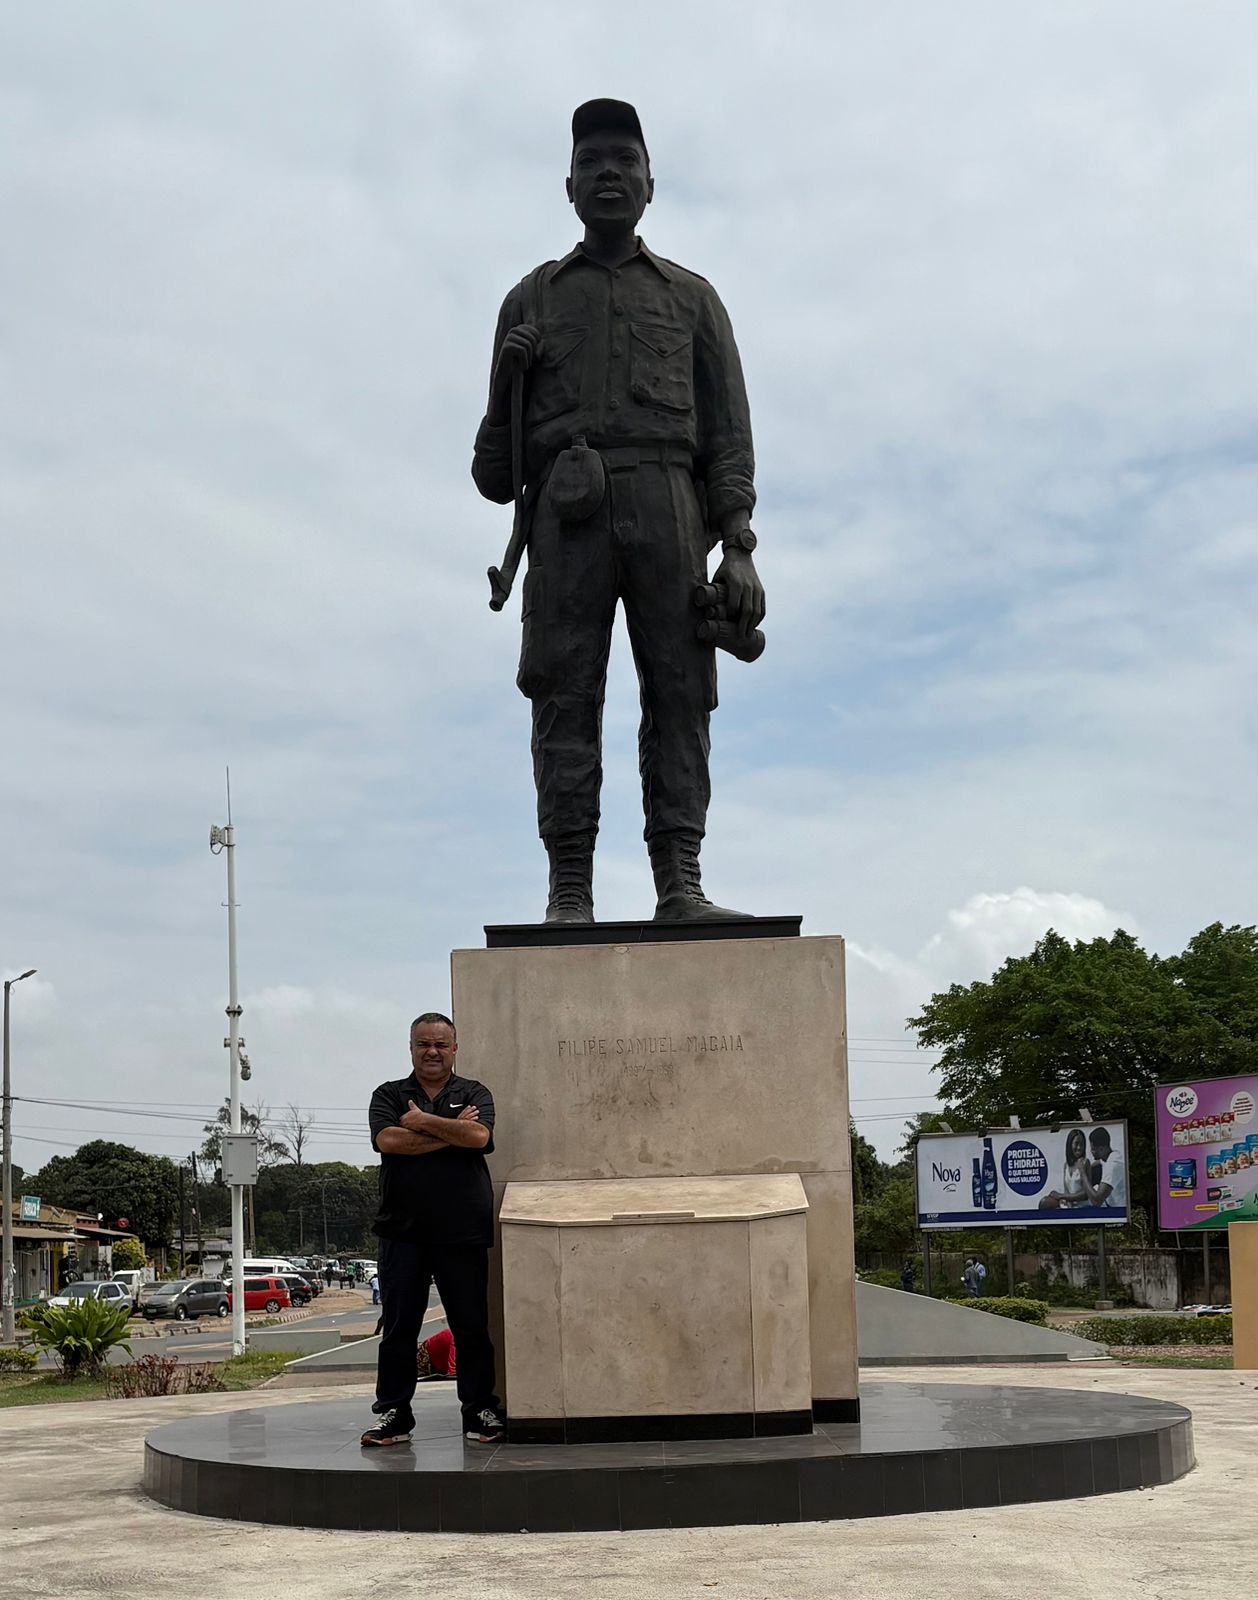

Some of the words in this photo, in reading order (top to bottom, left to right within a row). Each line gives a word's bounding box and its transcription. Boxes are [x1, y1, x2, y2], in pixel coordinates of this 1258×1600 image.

[558, 1039, 607, 1057] FILIPE
[616, 1037, 677, 1055] SAMUEL
[687, 1034, 744, 1053] MAGAIA
[1007, 1149, 1039, 1159] PROTEJA
[1008, 1160, 1013, 1169] E
[1013, 1158, 1045, 1169] HIDRATE
[932, 1162, 960, 1182] Nova
